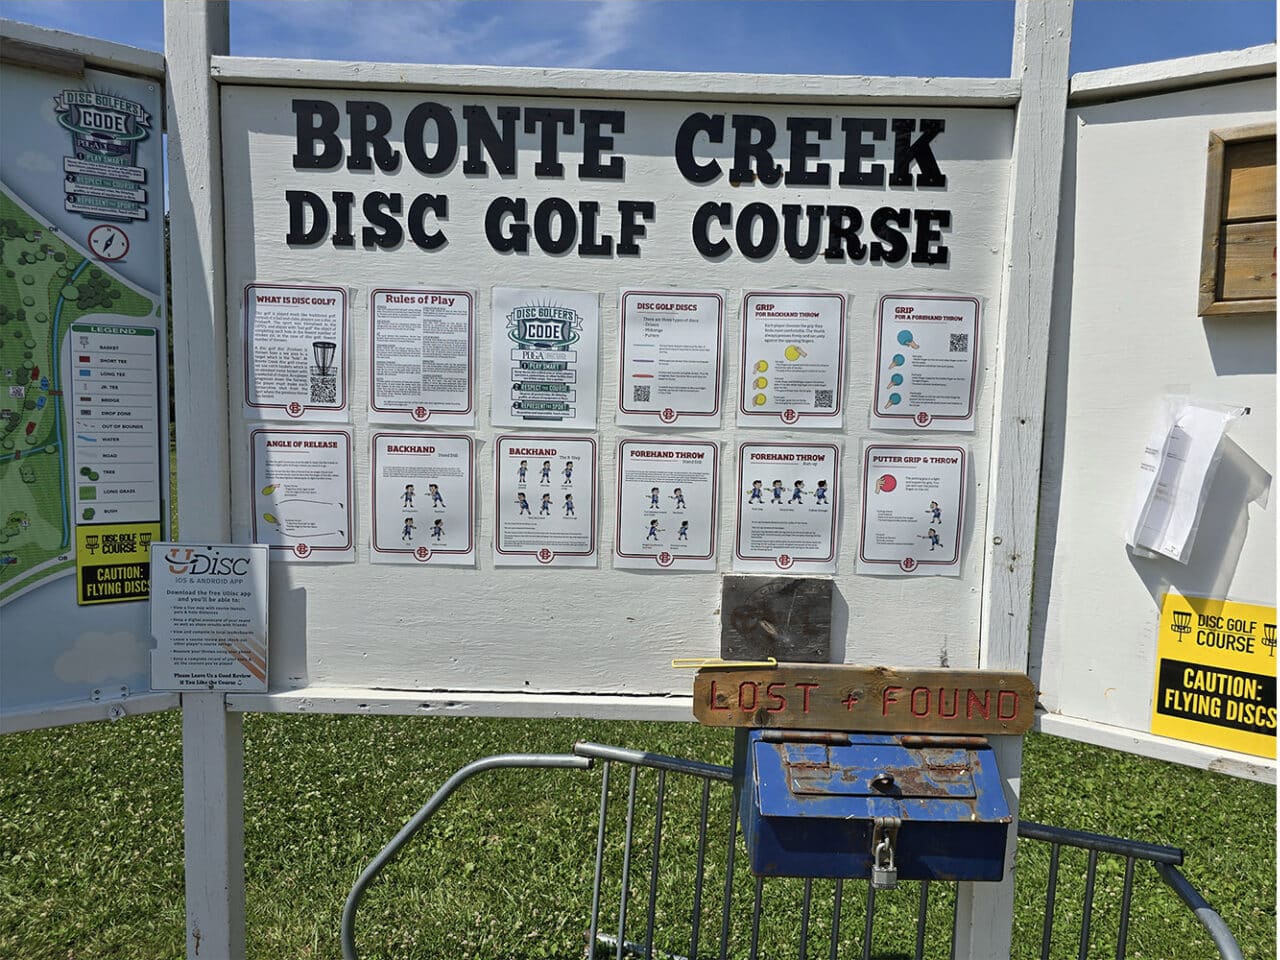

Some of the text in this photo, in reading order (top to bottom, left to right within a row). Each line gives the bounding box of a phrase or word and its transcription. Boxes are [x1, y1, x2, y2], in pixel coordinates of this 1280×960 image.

[66, 91, 92, 104] DISC
[82, 110, 123, 132] CODE
[291, 99, 947, 188] BRONTE CREEK
[285, 189, 951, 266] DISC GOLF COURSE
[256, 295, 336, 306] WHAT IS DISC GOLF?
[385, 294, 455, 307] Rules of Play
[637, 302, 655, 310] DISC
[755, 303, 775, 311] GRIP
[894, 306, 914, 314] GRIP
[516, 308, 537, 319] DISC
[90, 326, 137, 335] LEGEND
[528, 324, 560, 339] CODE
[266, 440, 292, 448] ANGLE
[387, 445, 436, 453] BACKHAND
[509, 447, 557, 456] BACKHAND
[630, 450, 705, 459] FOREHAND THROW
[750, 453, 795, 461] FOREHAND
[873, 455, 903, 463] PUTTER
[102, 533, 137, 542] DISC GOLF
[102, 543, 137, 554] COURSE
[97, 565, 144, 581] CAUTION:
[197, 577, 228, 585] ANDROID
[87, 582, 122, 597] FLYING
[1197, 613, 1257, 634] DISC GOLF
[1196, 628, 1255, 654] COURSE
[1183, 667, 1263, 703] CAUTION:
[709, 679, 1020, 721] LOST + FOUND
[1164, 686, 1277, 730] FLYING DISCS
